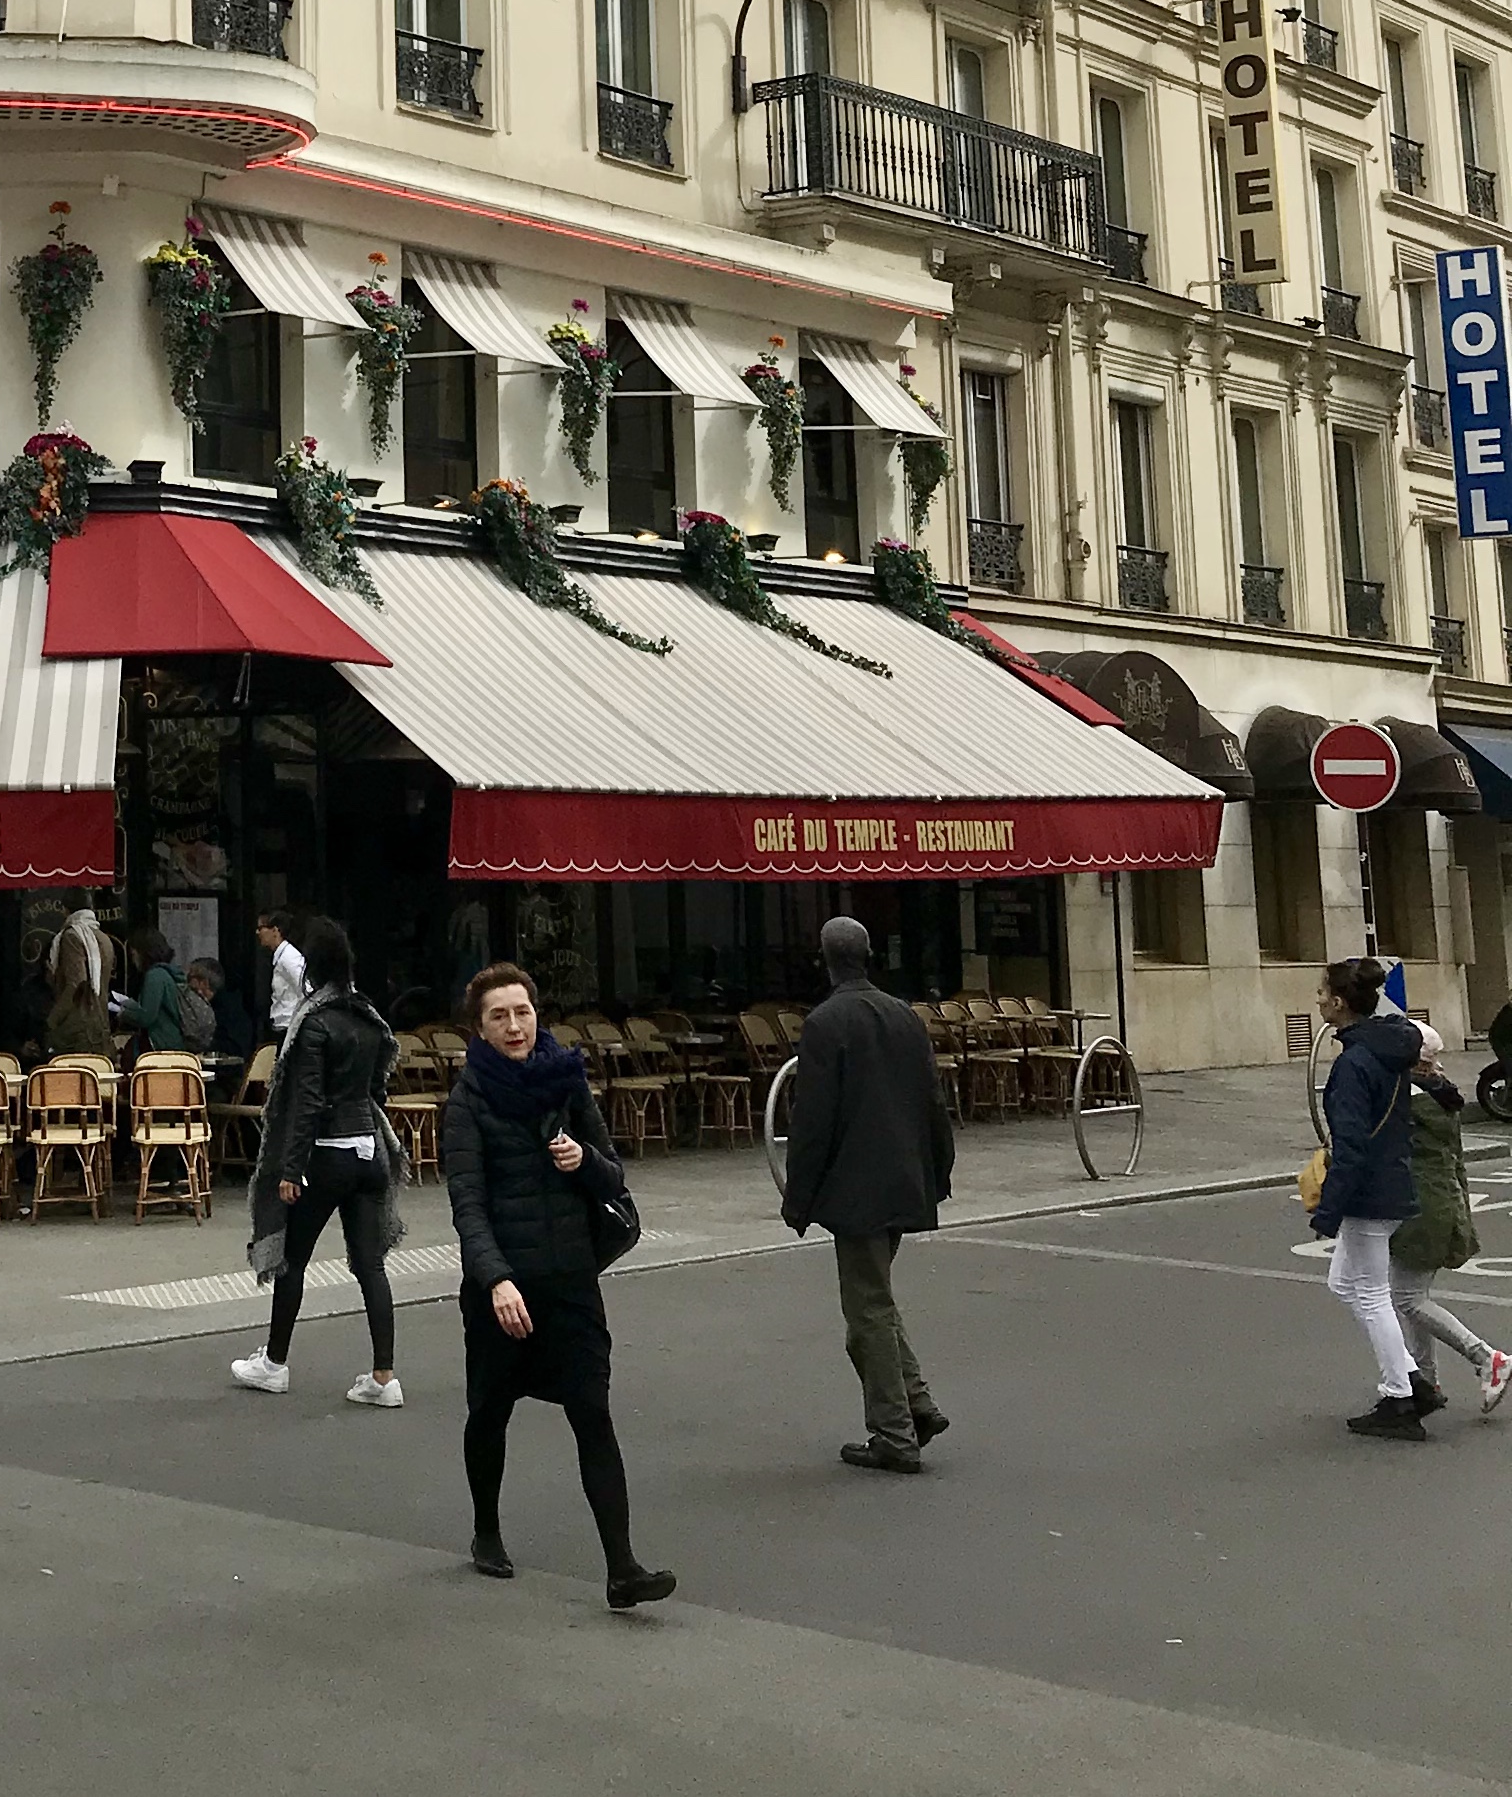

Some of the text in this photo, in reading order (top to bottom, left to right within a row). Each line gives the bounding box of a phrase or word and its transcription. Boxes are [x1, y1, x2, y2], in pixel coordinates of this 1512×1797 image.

[1445, 252, 1508, 533] HOTEL
[753, 813, 797, 852] CAFÉ
[803, 818, 828, 852] DU
[833, 819, 898, 852] TEMPLE
[915, 820, 1015, 852] RESTAURANT
